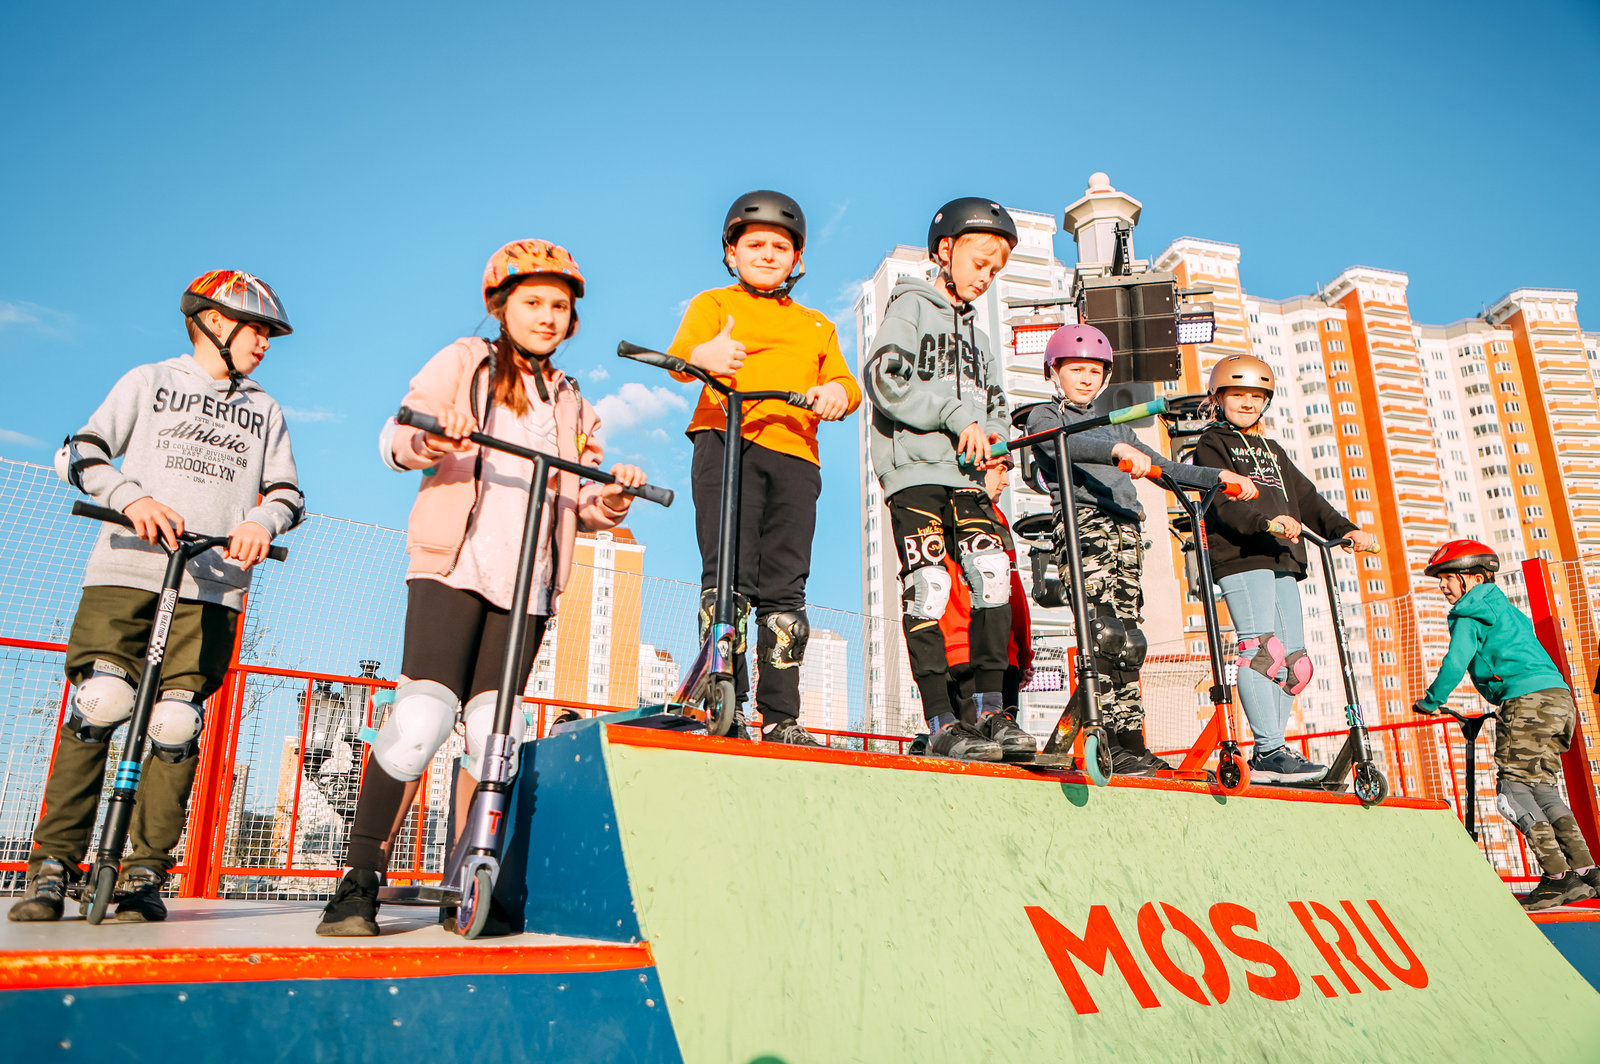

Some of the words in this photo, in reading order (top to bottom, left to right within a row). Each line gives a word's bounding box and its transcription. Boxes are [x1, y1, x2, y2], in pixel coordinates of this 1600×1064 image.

[153, 387, 265, 440] SUPERIOR
[158, 420, 250, 453] Athletic
[156, 439, 170, 449] 19
[172, 443, 204, 454] COLLEGE
[206, 450, 235, 462] DIVISION
[236, 456, 248, 468] 68
[165, 455, 236, 483] BROOKLYN
[181, 449, 201, 458] EAST
[203, 454, 226, 464] COAST
[1023, 899, 1430, 1015] MOS.RU
